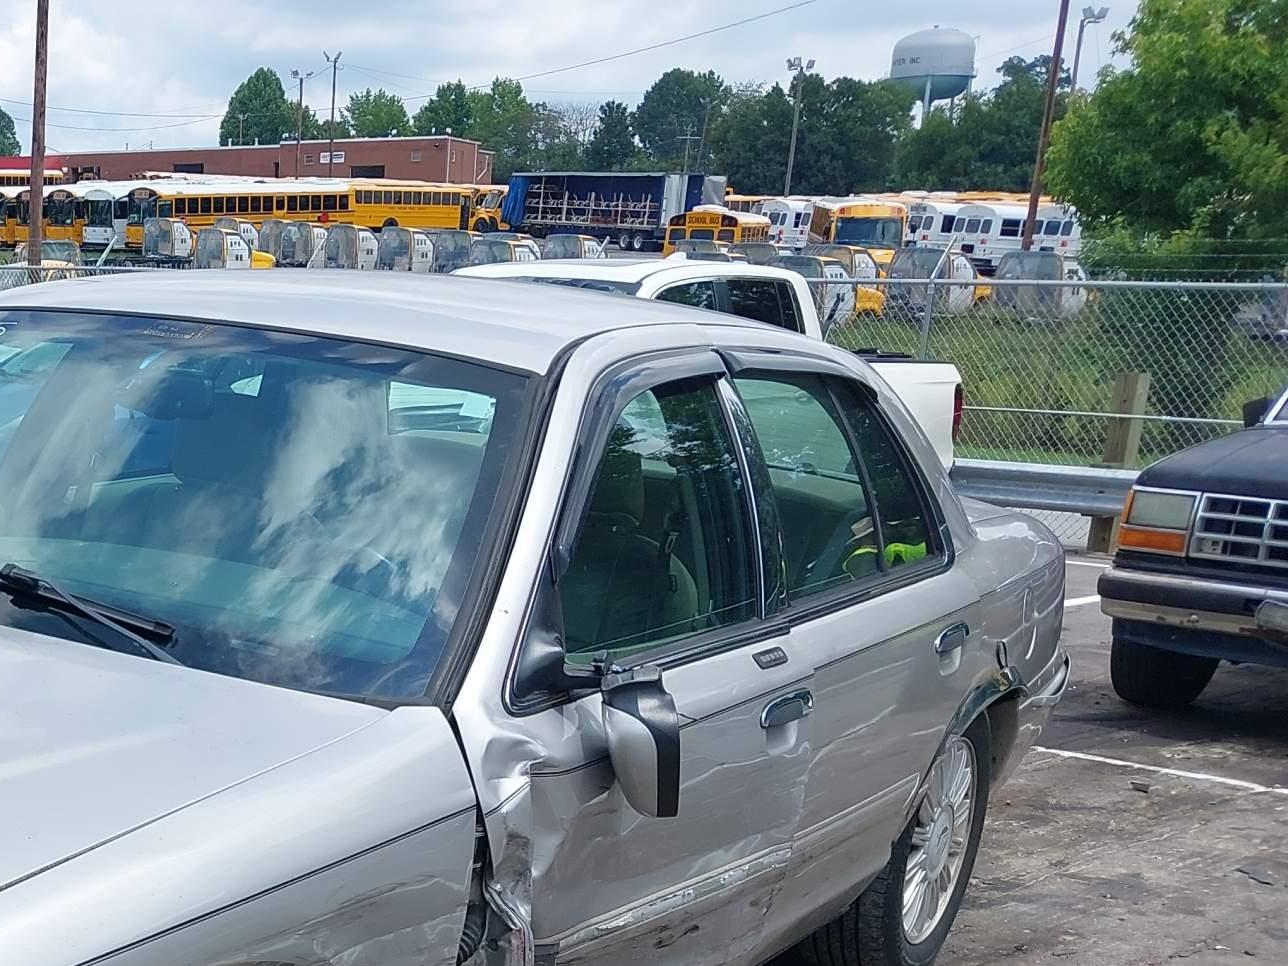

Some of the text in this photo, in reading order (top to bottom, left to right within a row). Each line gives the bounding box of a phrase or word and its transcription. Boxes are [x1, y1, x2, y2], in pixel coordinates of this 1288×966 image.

[909, 56, 920, 65] INC
[688, 216, 720, 224] SCHOOL BUS
